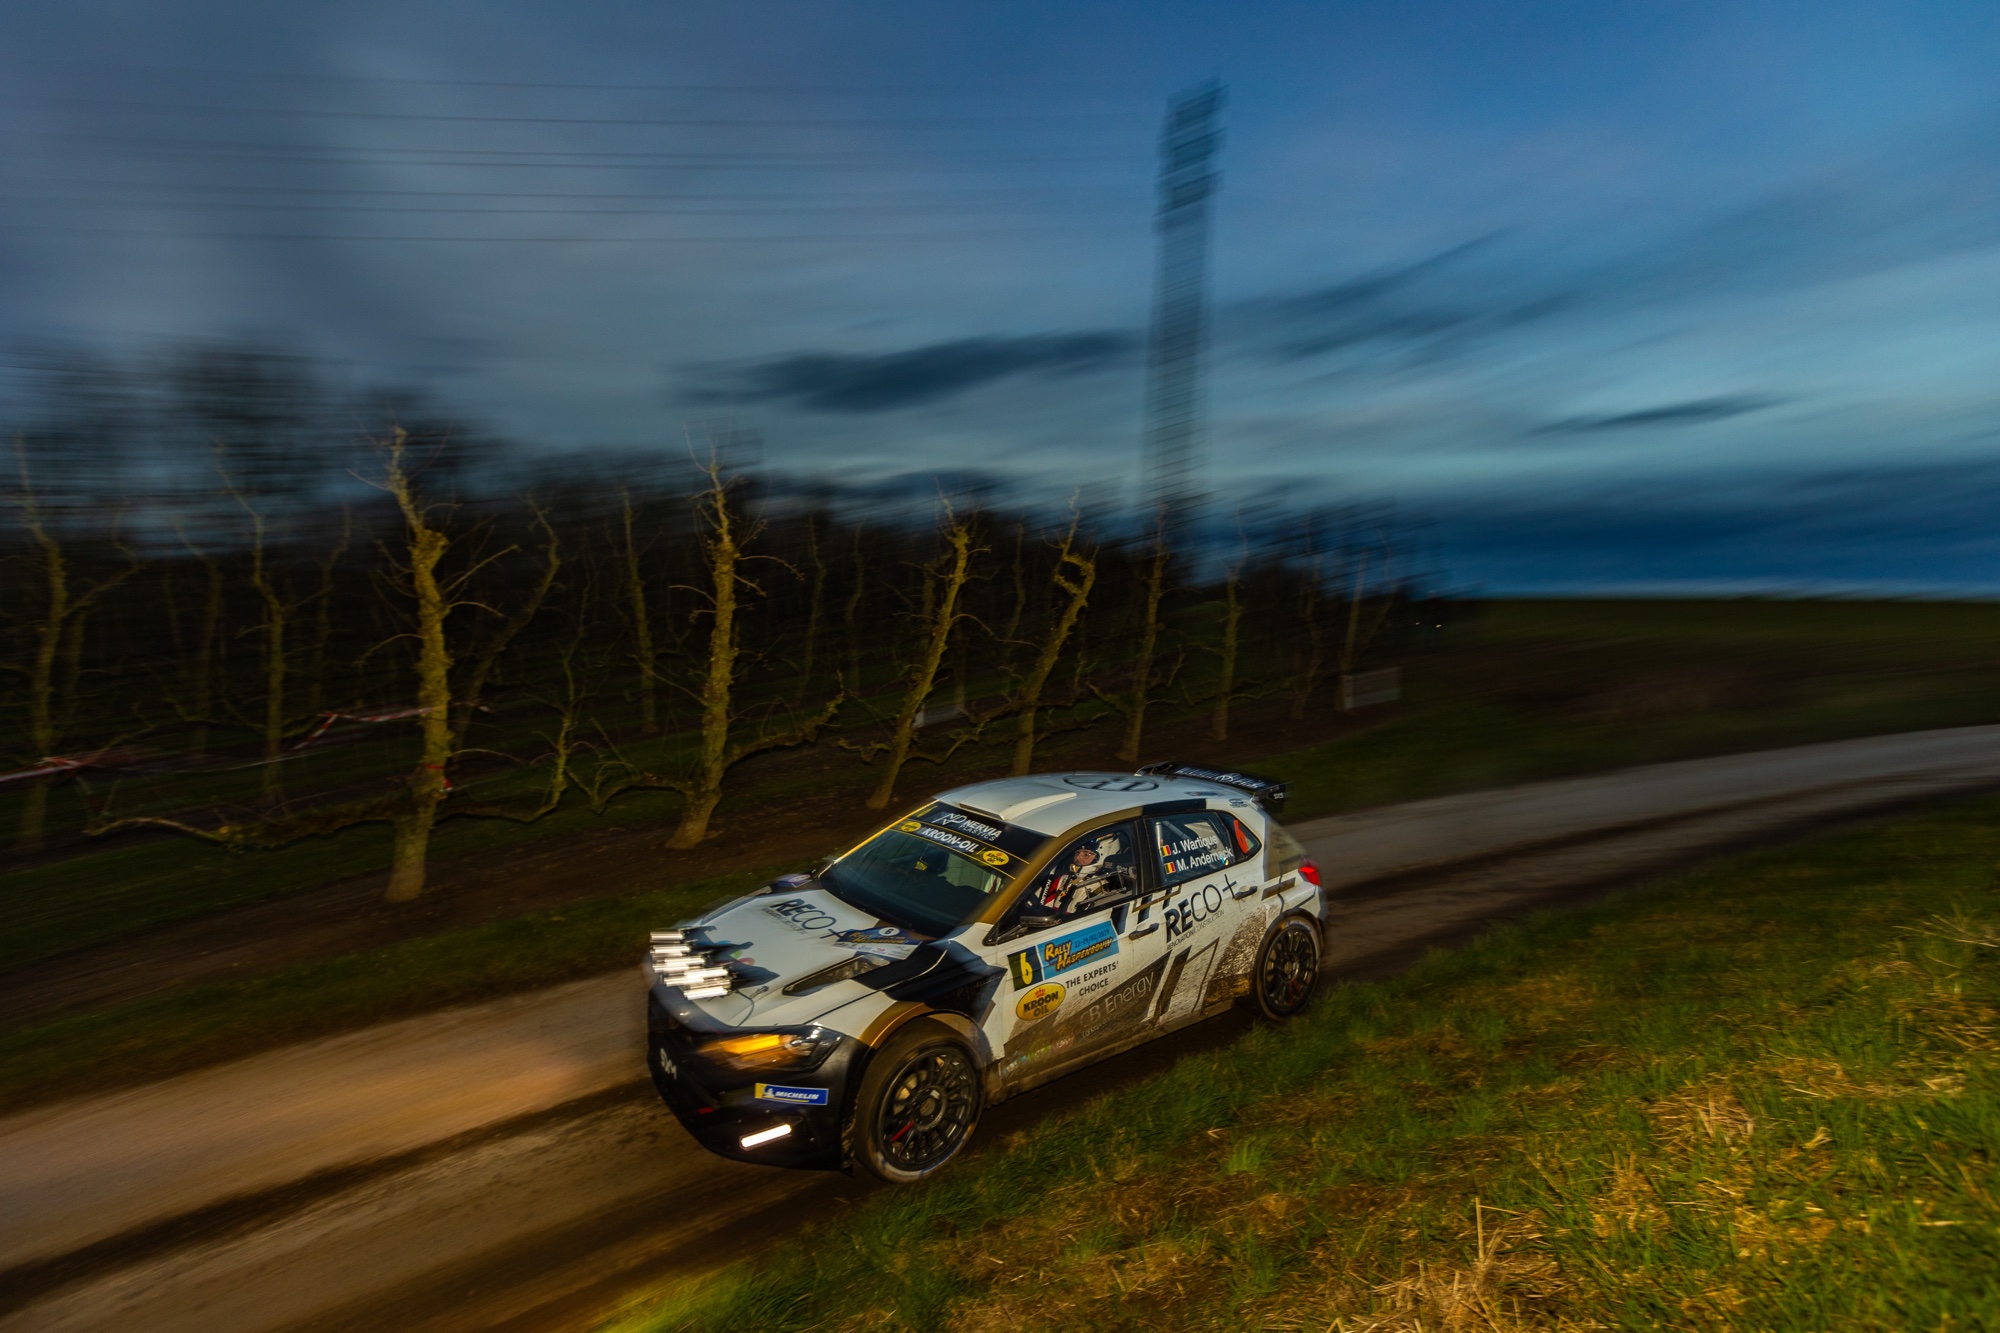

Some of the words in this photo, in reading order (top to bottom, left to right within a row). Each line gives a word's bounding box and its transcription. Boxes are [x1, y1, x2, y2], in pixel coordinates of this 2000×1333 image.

[958, 825, 998, 842] PLASTICS
[964, 819, 1002, 838] NERVIA
[1233, 819, 1249, 853] 6
[921, 827, 979, 853] KROON-OIL
[1172, 842, 1181, 855] J.
[1180, 834, 1219, 853] Wartique
[1176, 860, 1189, 872] M.
[1044, 941, 1072, 962] RALLY
[1020, 951, 1034, 985] 6
[1065, 976, 1081, 989] THE
[1079, 977, 1109, 997] CHOICE
[1104, 971, 1154, 1014] Energy
[1023, 990, 1059, 1013] KROON
[1033, 1004, 1049, 1017] OIL
[775, 1091, 819, 1100] MICHELIN
